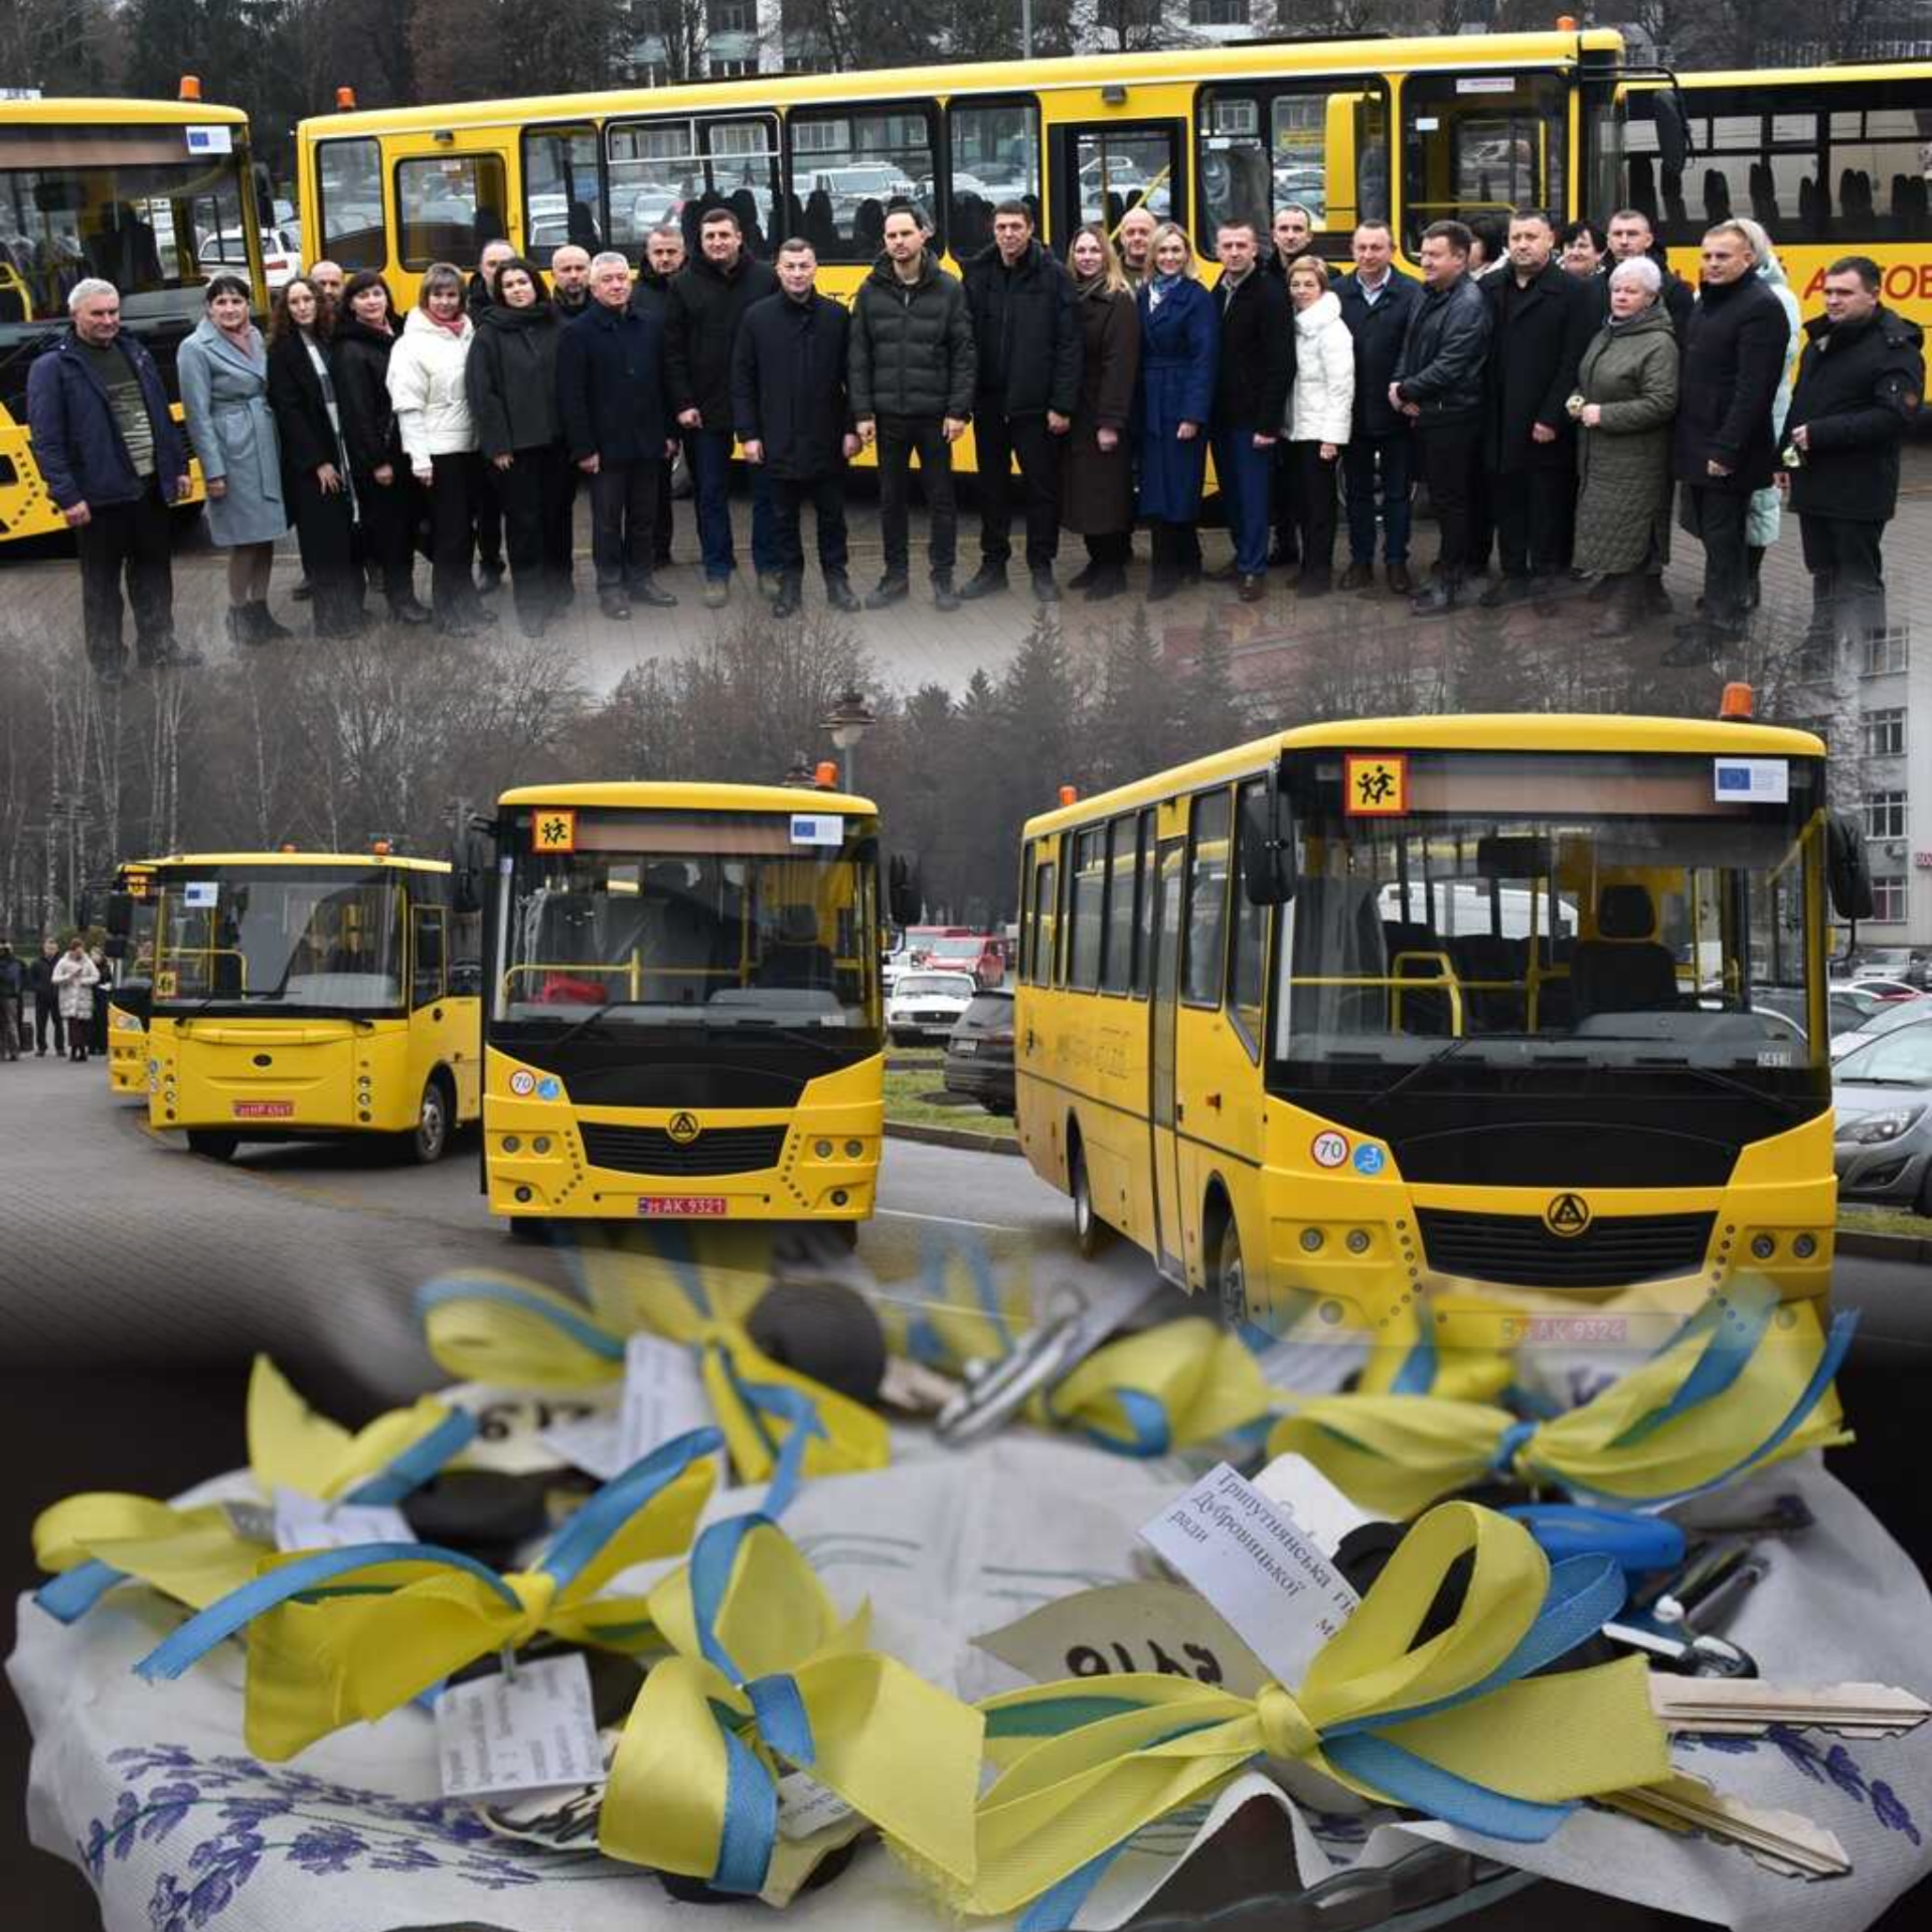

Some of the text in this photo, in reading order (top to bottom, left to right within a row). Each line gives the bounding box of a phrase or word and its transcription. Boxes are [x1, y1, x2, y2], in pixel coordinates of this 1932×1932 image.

[1319, 1140, 1343, 1159] 70
[1574, 1321, 1623, 1341] 9324
[1168, 1510, 1208, 1543] ради
[1192, 1491, 1307, 1597] Дубровицької
